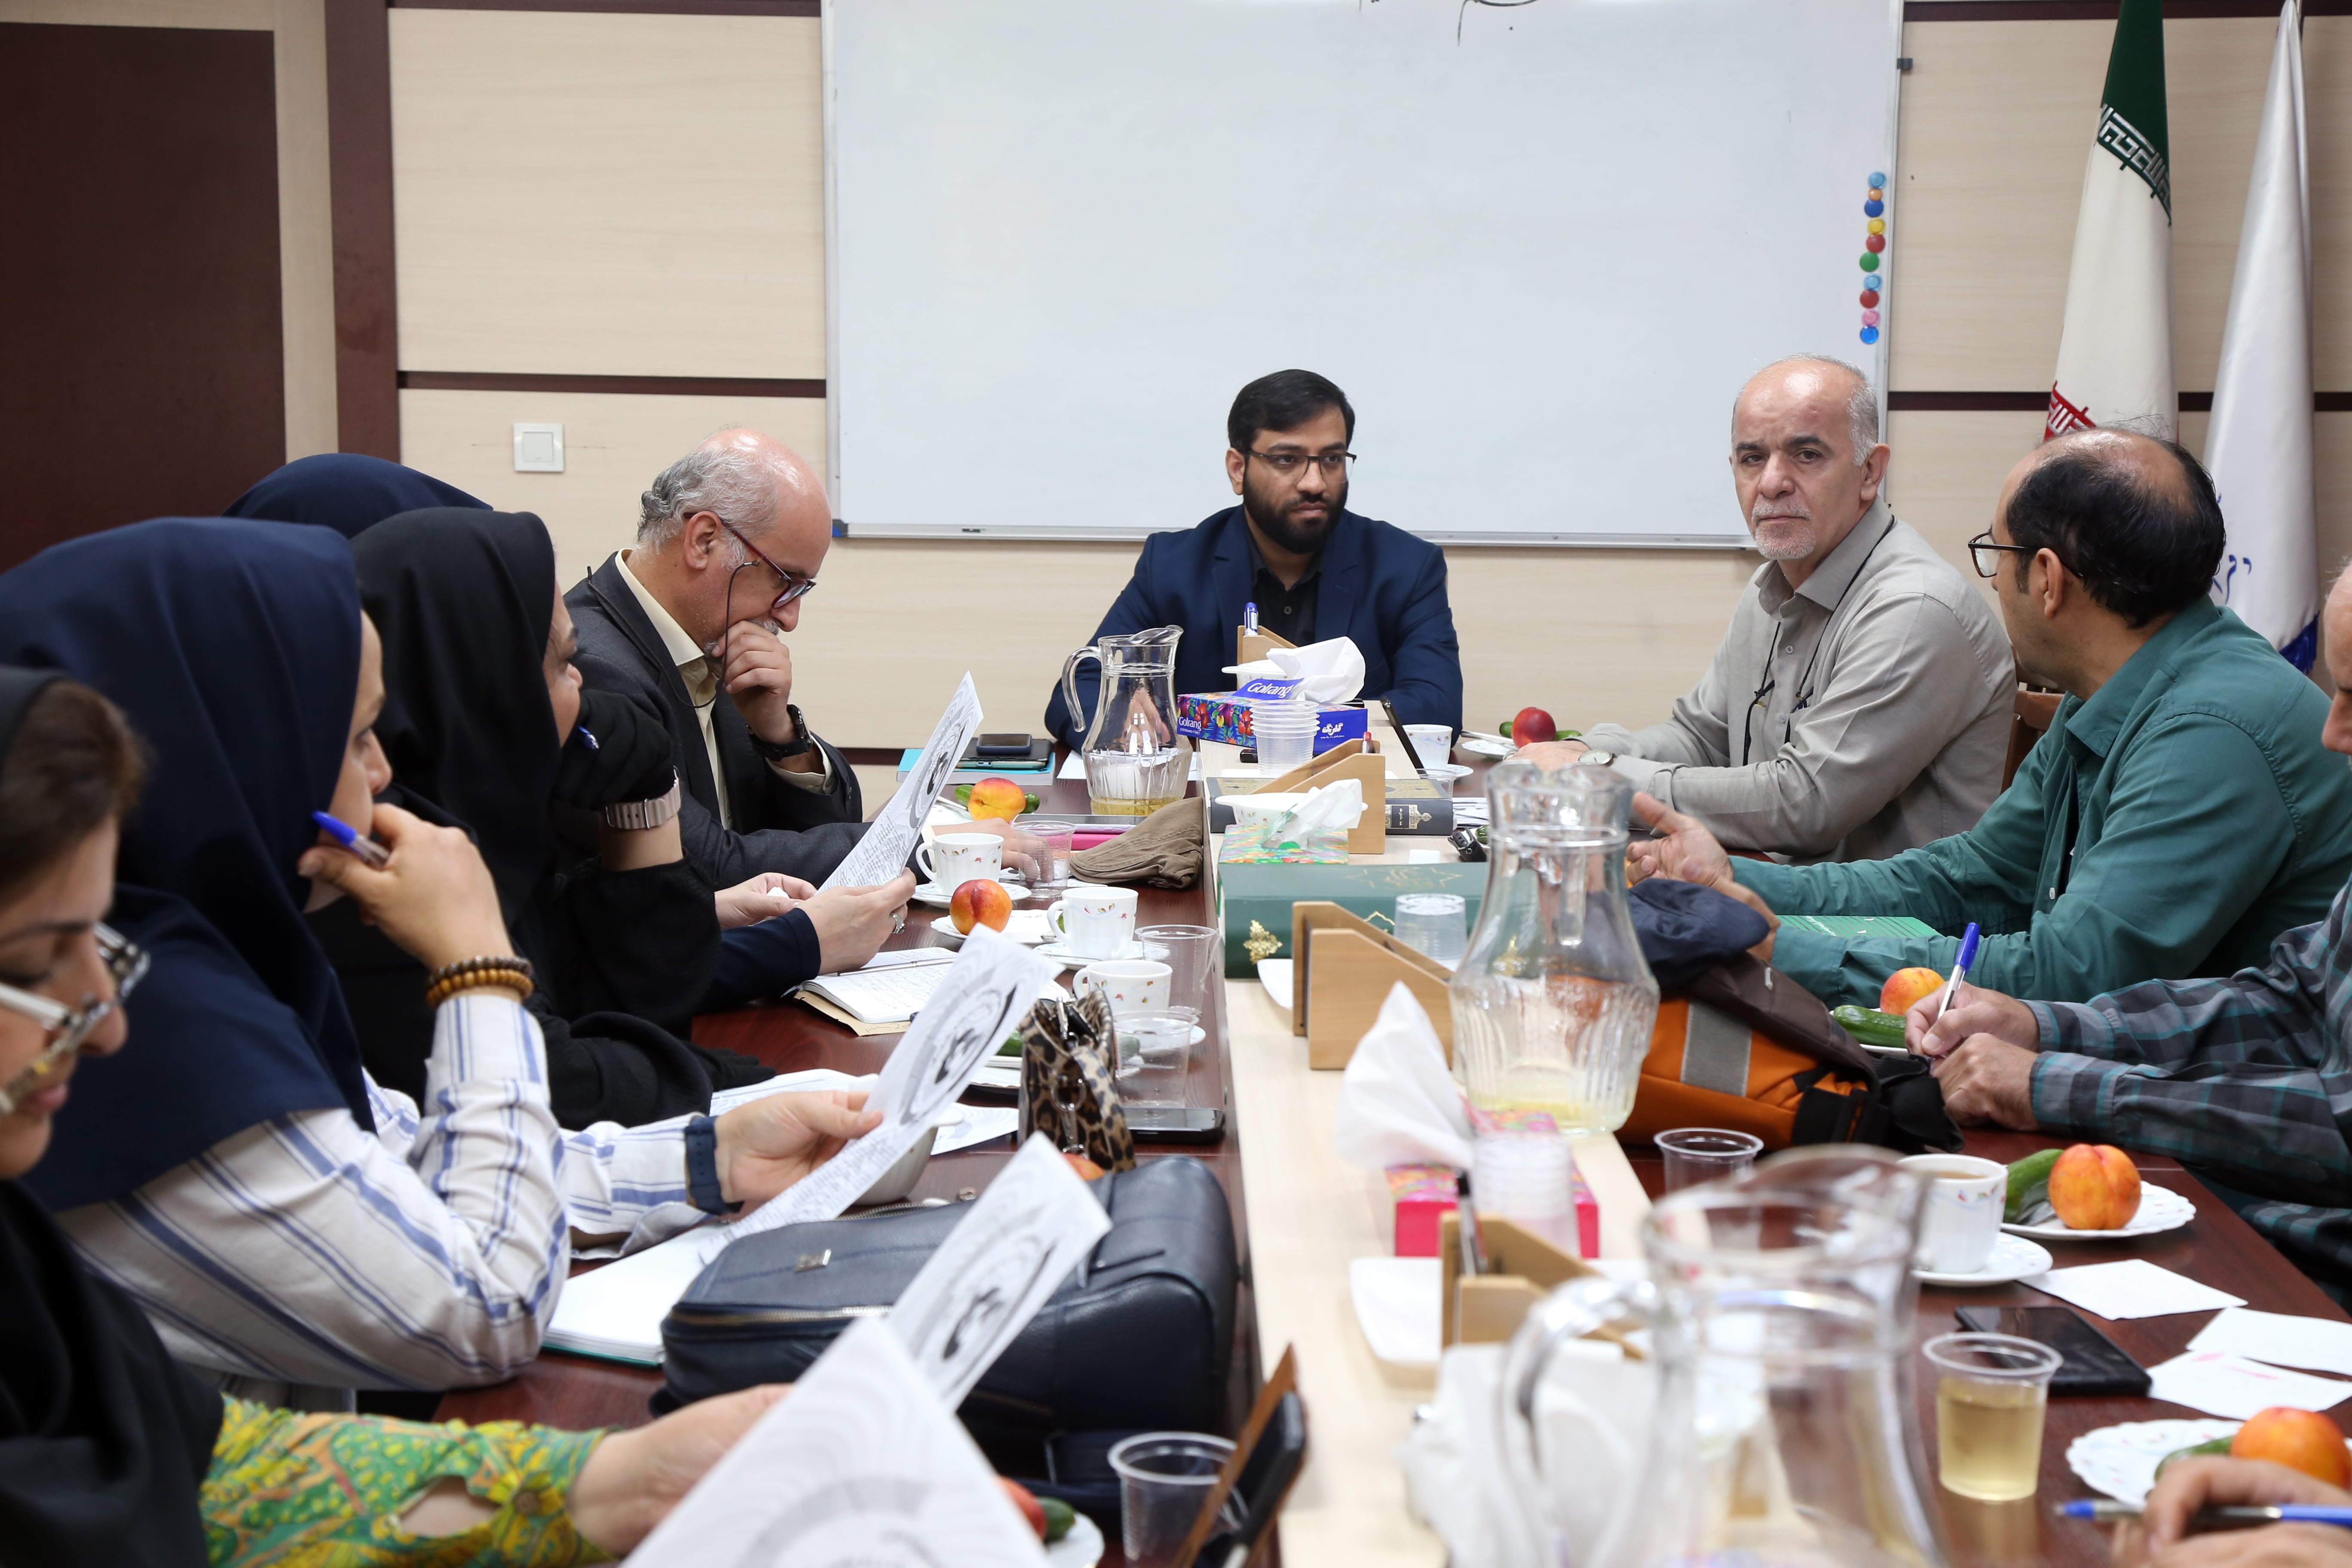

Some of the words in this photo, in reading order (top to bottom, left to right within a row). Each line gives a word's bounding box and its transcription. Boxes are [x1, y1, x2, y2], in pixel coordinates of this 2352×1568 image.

[1247, 683, 1294, 698] Golrang
[1179, 717, 1201, 732] Golrang
[1322, 722, 1344, 736] گلرنگ
